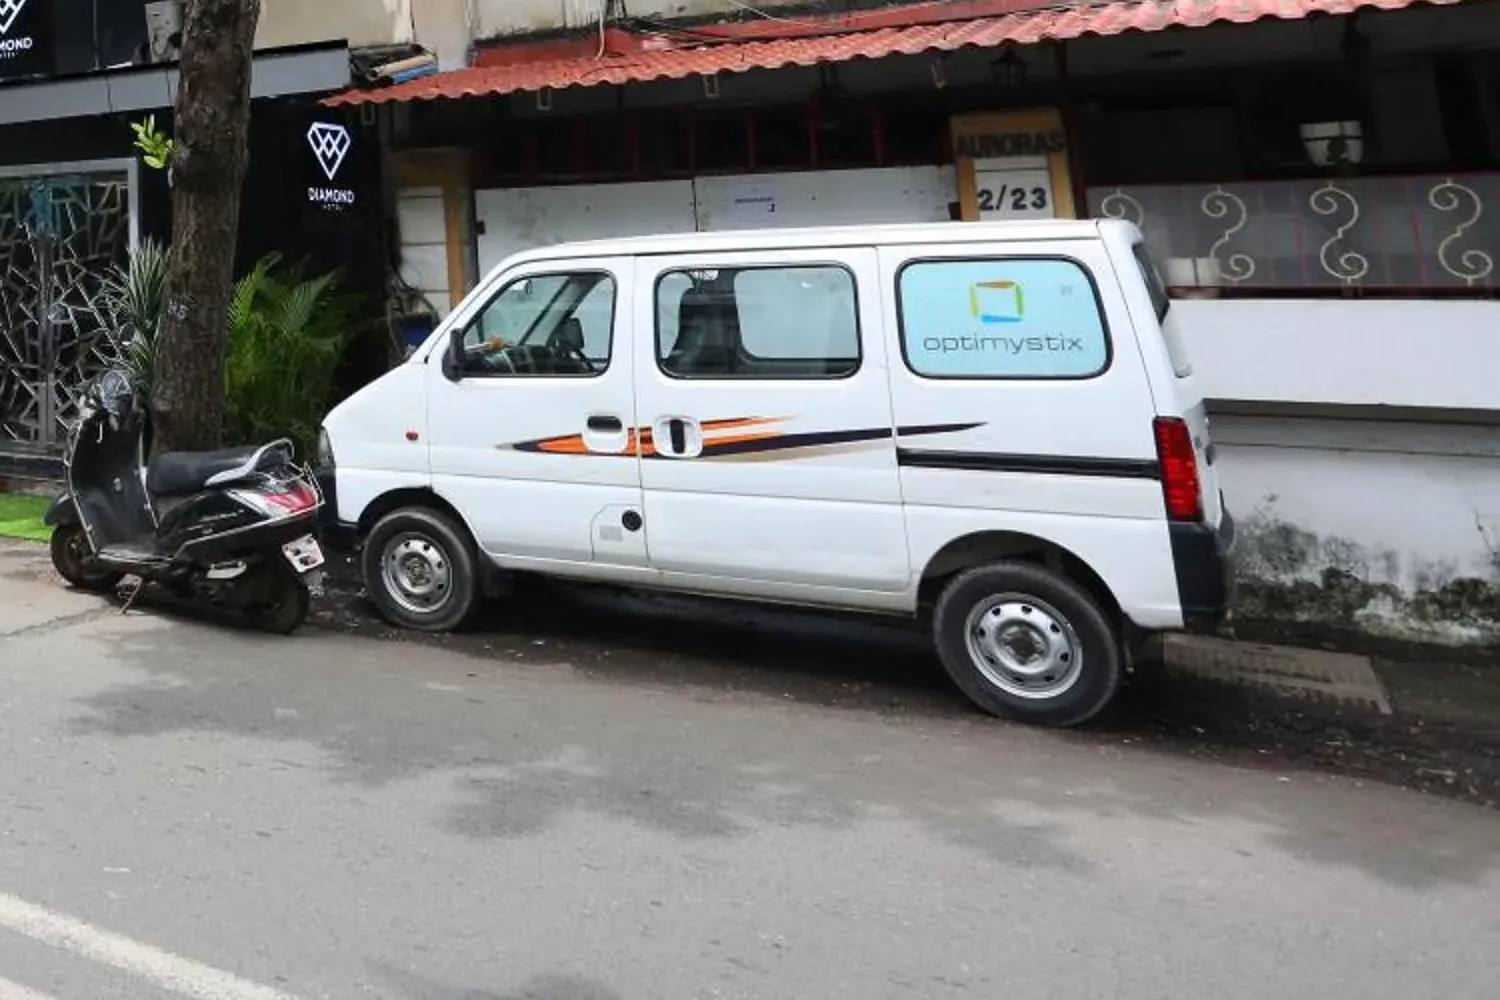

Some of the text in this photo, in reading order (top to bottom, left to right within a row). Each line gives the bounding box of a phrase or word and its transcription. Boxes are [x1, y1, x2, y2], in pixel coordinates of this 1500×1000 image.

[307, 187, 355, 203] DIAMOND
[977, 184, 1047, 211] 2/23
[923, 333, 1084, 355] optimystix
